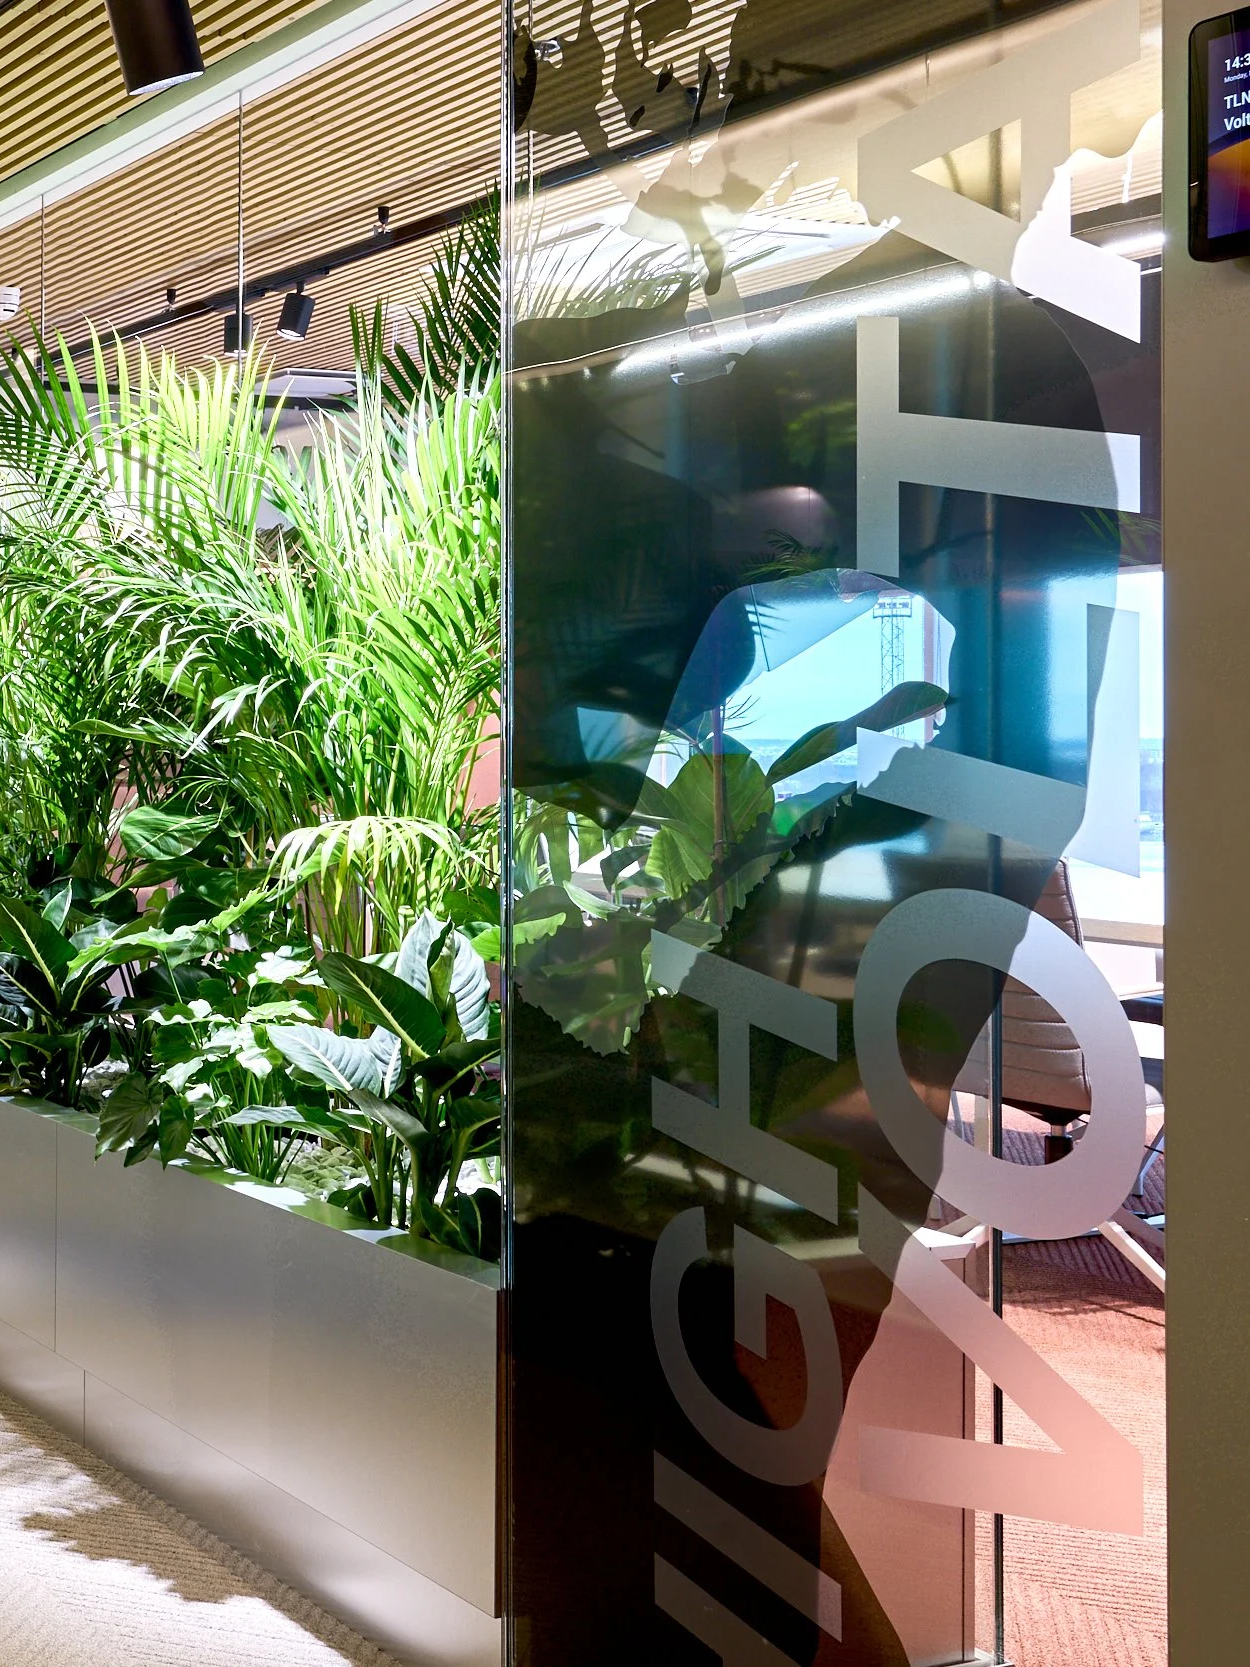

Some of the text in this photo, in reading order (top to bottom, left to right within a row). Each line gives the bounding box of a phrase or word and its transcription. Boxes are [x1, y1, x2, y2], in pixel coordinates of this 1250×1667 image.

[1224, 72, 1248, 83] Monday,
[1224, 90, 1250, 109] TLN
[1224, 113, 1250, 130] Volt
[853, 0, 1146, 1537] VOLTA
